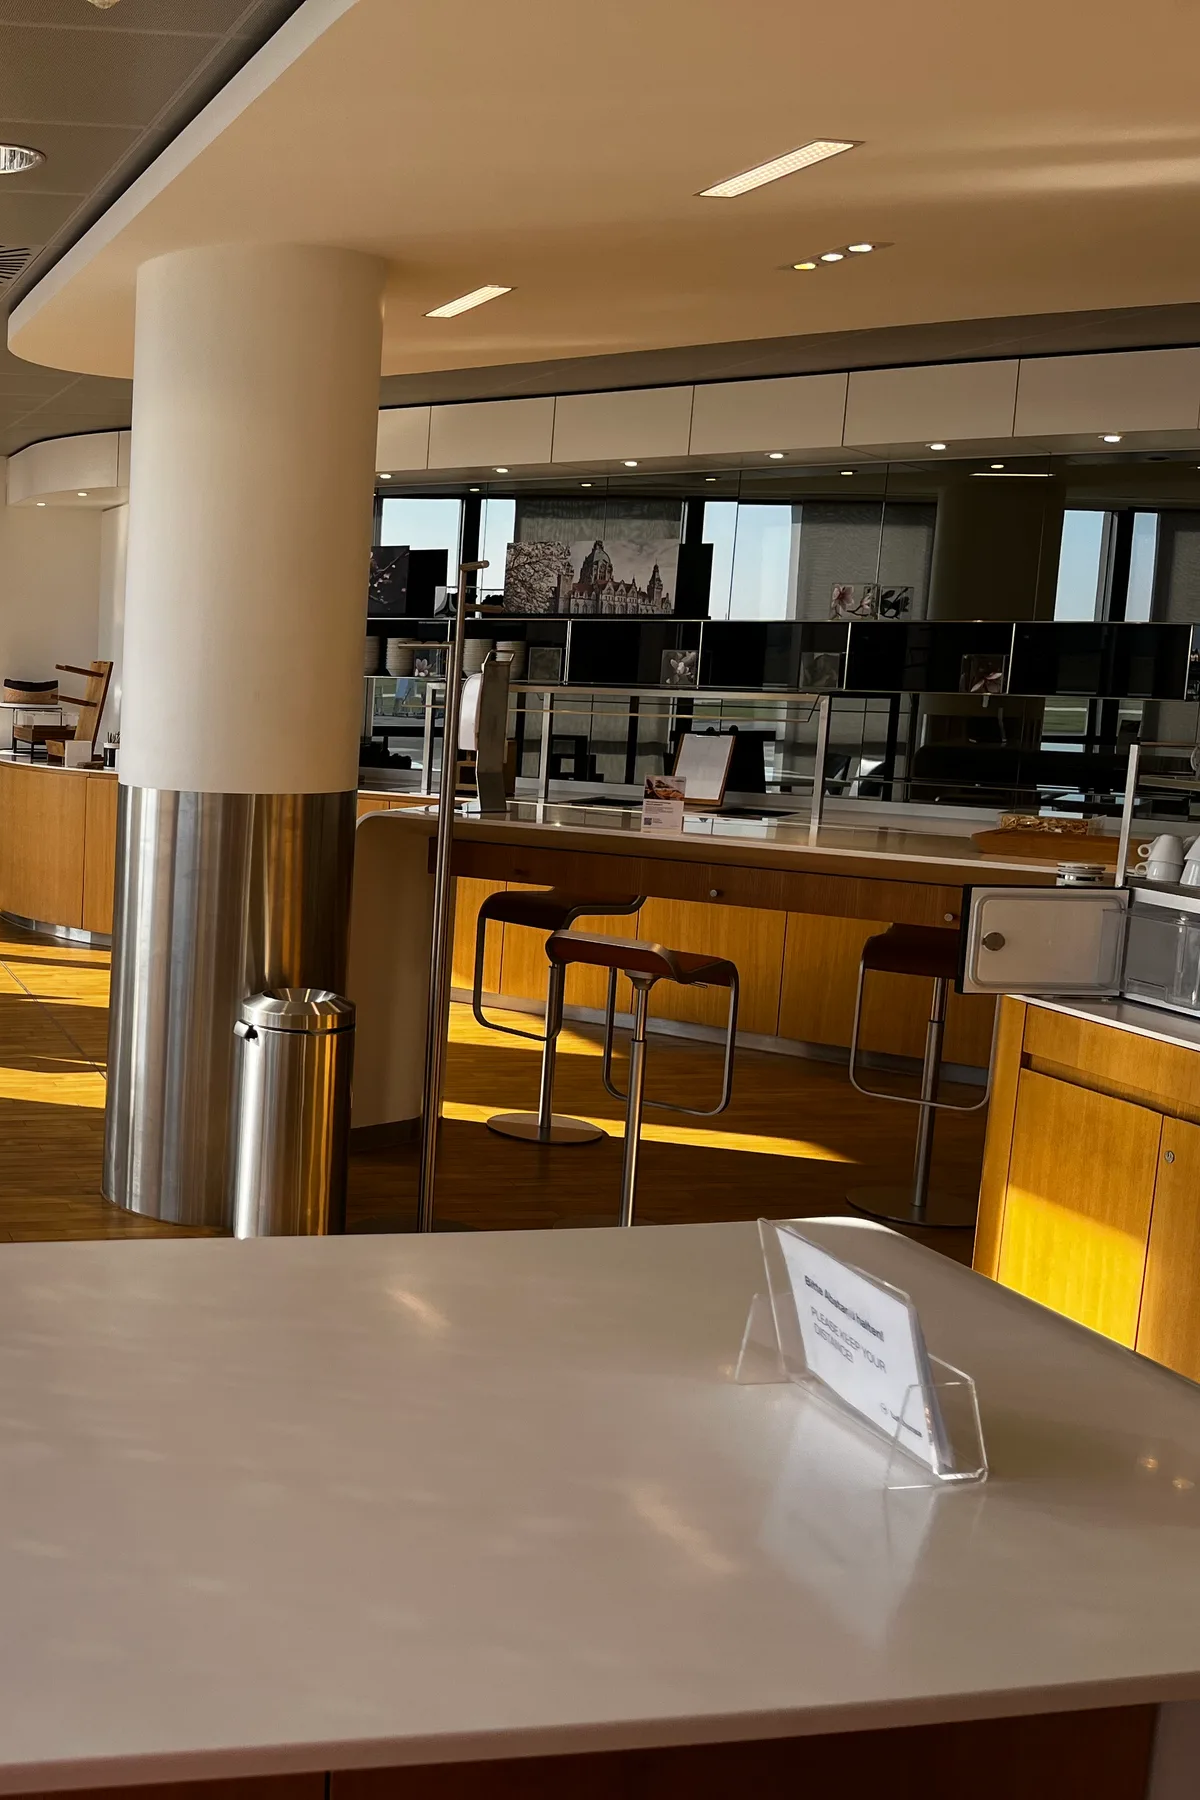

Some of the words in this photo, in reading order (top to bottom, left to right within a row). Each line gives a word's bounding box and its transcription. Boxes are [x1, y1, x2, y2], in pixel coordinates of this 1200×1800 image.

[804, 1275, 823, 1296] Bitte
[810, 1306, 840, 1337] PLEASE
[839, 1328, 860, 1351] KEEP
[861, 1344, 887, 1374] YOUR
[813, 1322, 854, 1364] DISTANCE!
